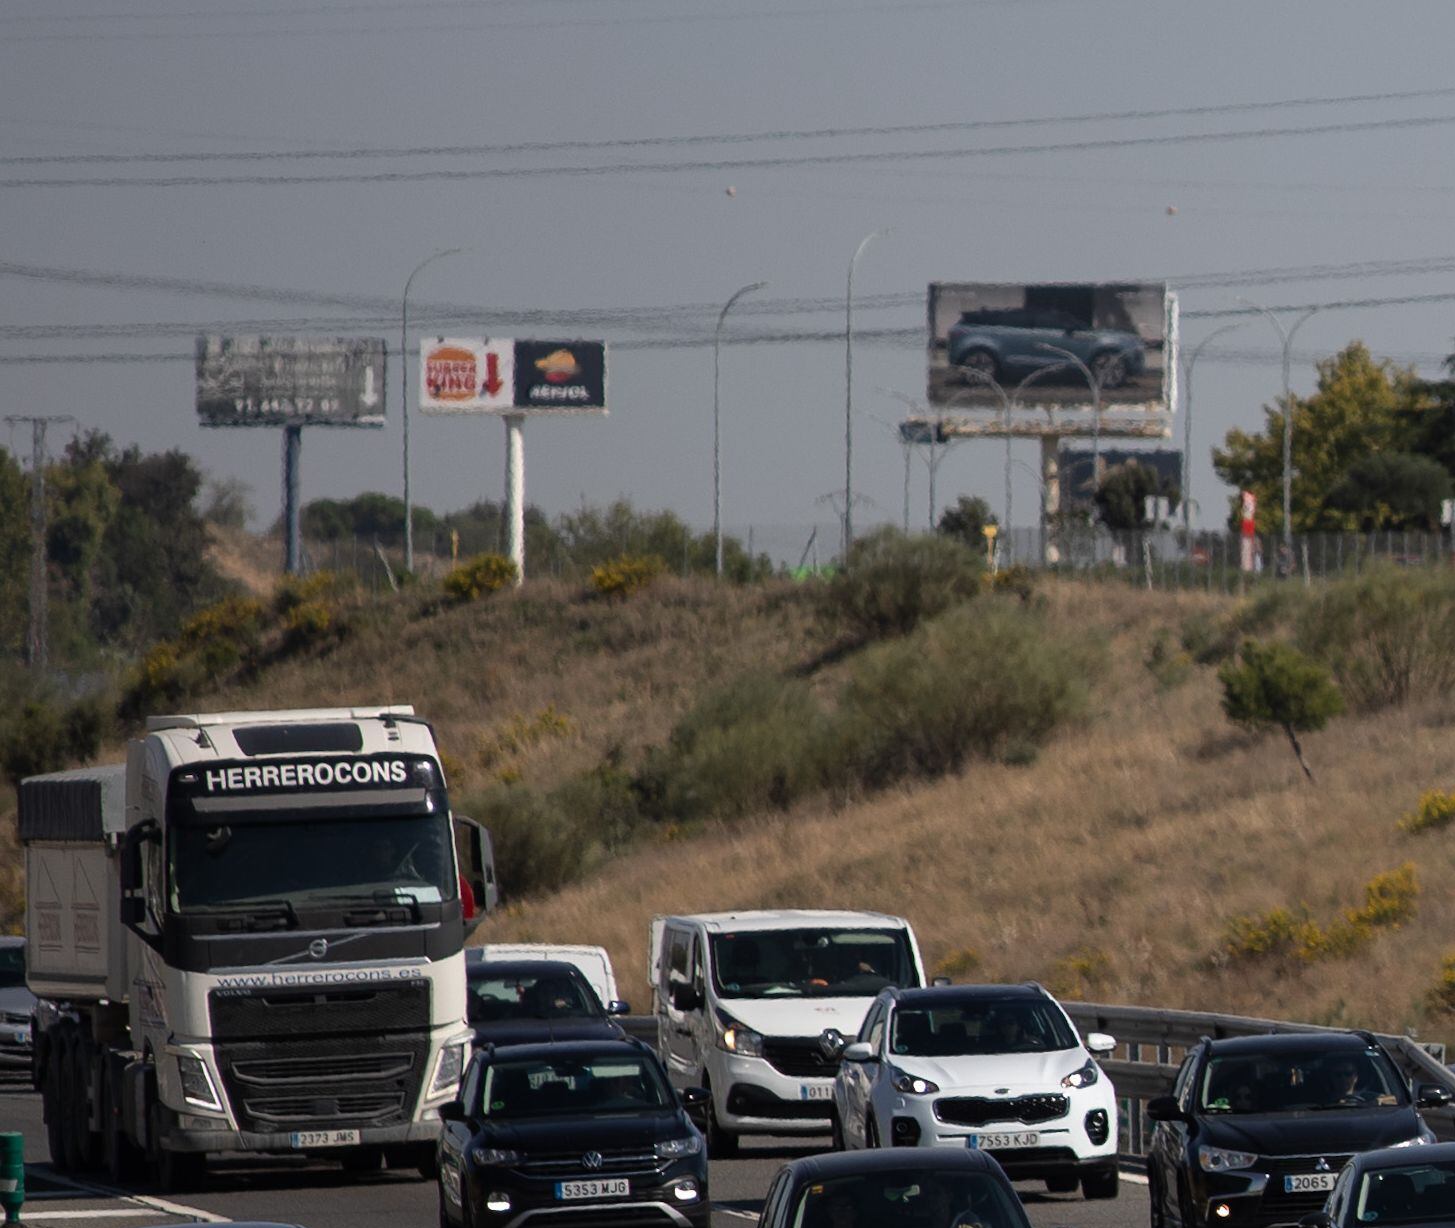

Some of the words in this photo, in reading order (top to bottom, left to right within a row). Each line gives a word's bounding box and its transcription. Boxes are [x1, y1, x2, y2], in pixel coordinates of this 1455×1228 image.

[206, 760, 407, 791] HERREROCONS
[217, 966, 422, 987] www.herrerocons.es
[979, 1134, 1010, 1147] 7553
[1013, 1133, 1038, 1146] KJD
[564, 1183, 597, 1196] 5353
[601, 1181, 626, 1194] MJG
[1294, 1176, 1328, 1189] 2065
